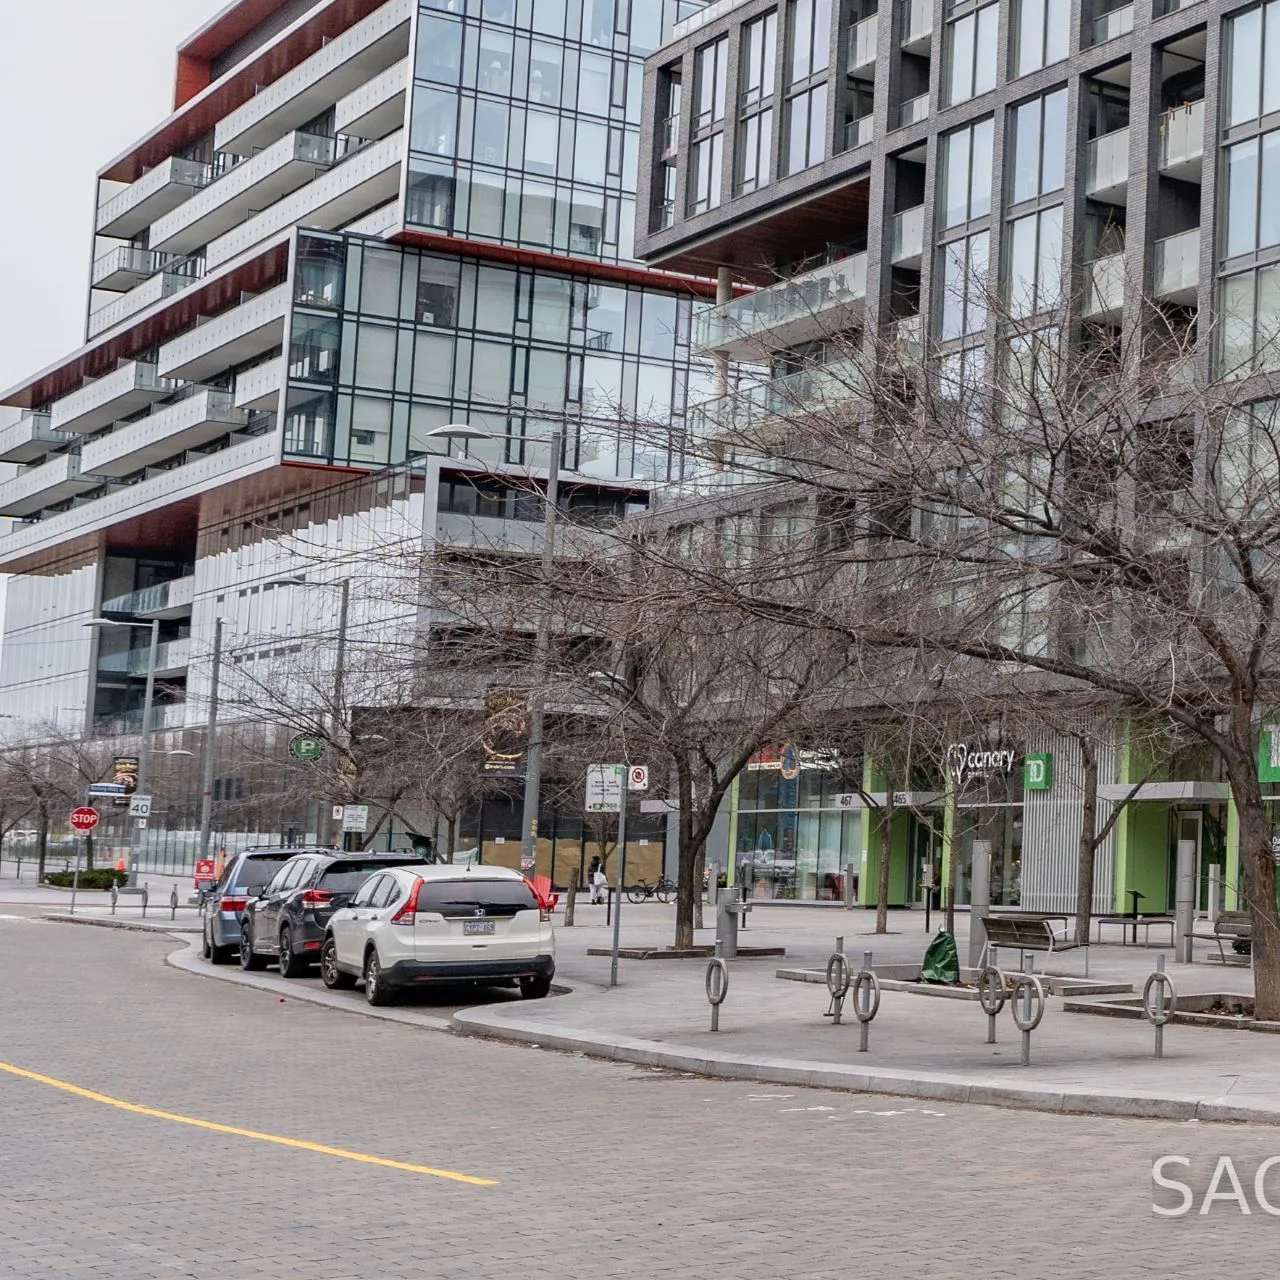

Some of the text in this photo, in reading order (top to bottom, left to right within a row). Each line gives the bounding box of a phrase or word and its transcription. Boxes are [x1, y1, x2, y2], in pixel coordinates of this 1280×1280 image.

[968, 749, 1014, 771] canary
[1027, 759, 1045, 783] TD
[840, 795, 853, 806] 467
[132, 804, 149, 814] 40
[72, 813, 98, 824] STOP
